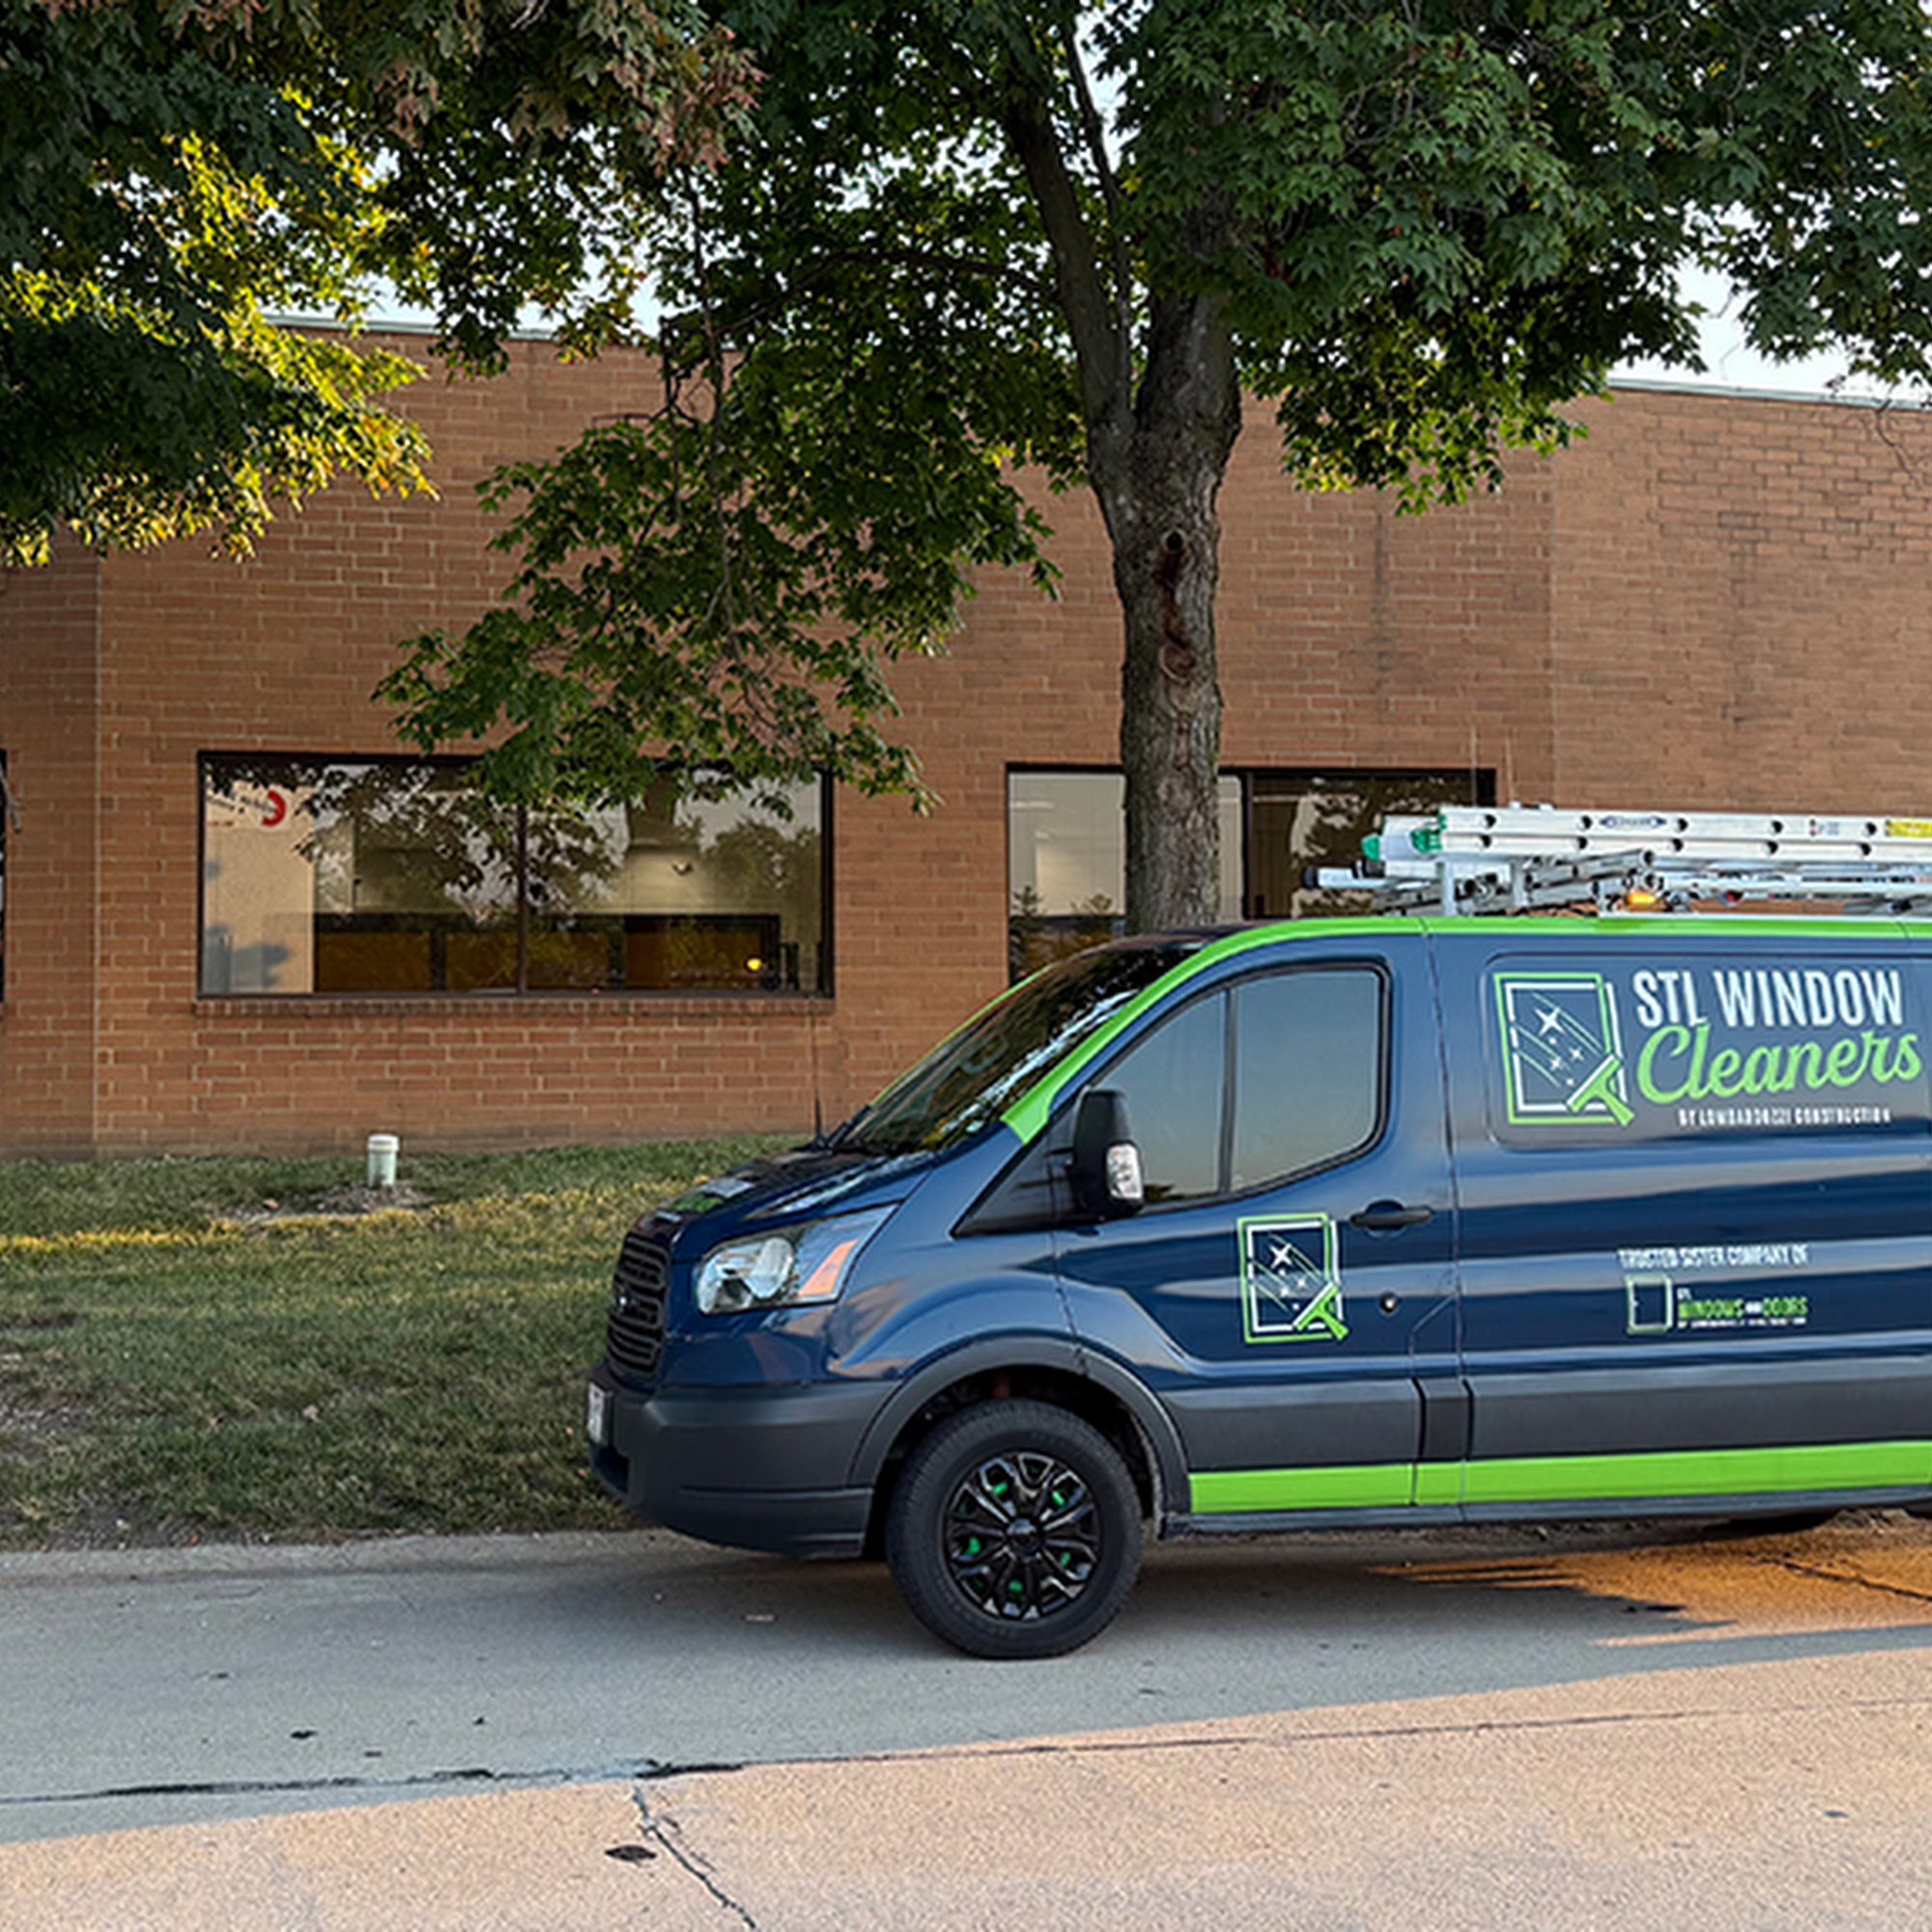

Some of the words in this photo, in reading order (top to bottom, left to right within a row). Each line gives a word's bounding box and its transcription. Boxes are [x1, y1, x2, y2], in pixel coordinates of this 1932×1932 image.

[1634, 970, 1709, 1027] STL
[1713, 970, 1904, 1027] WINDOW
[1636, 1023, 1922, 1104] Cleaners
[1794, 1107, 1891, 1124] CONSTRUCTION
[1726, 1244, 1789, 1266] COMPANY
